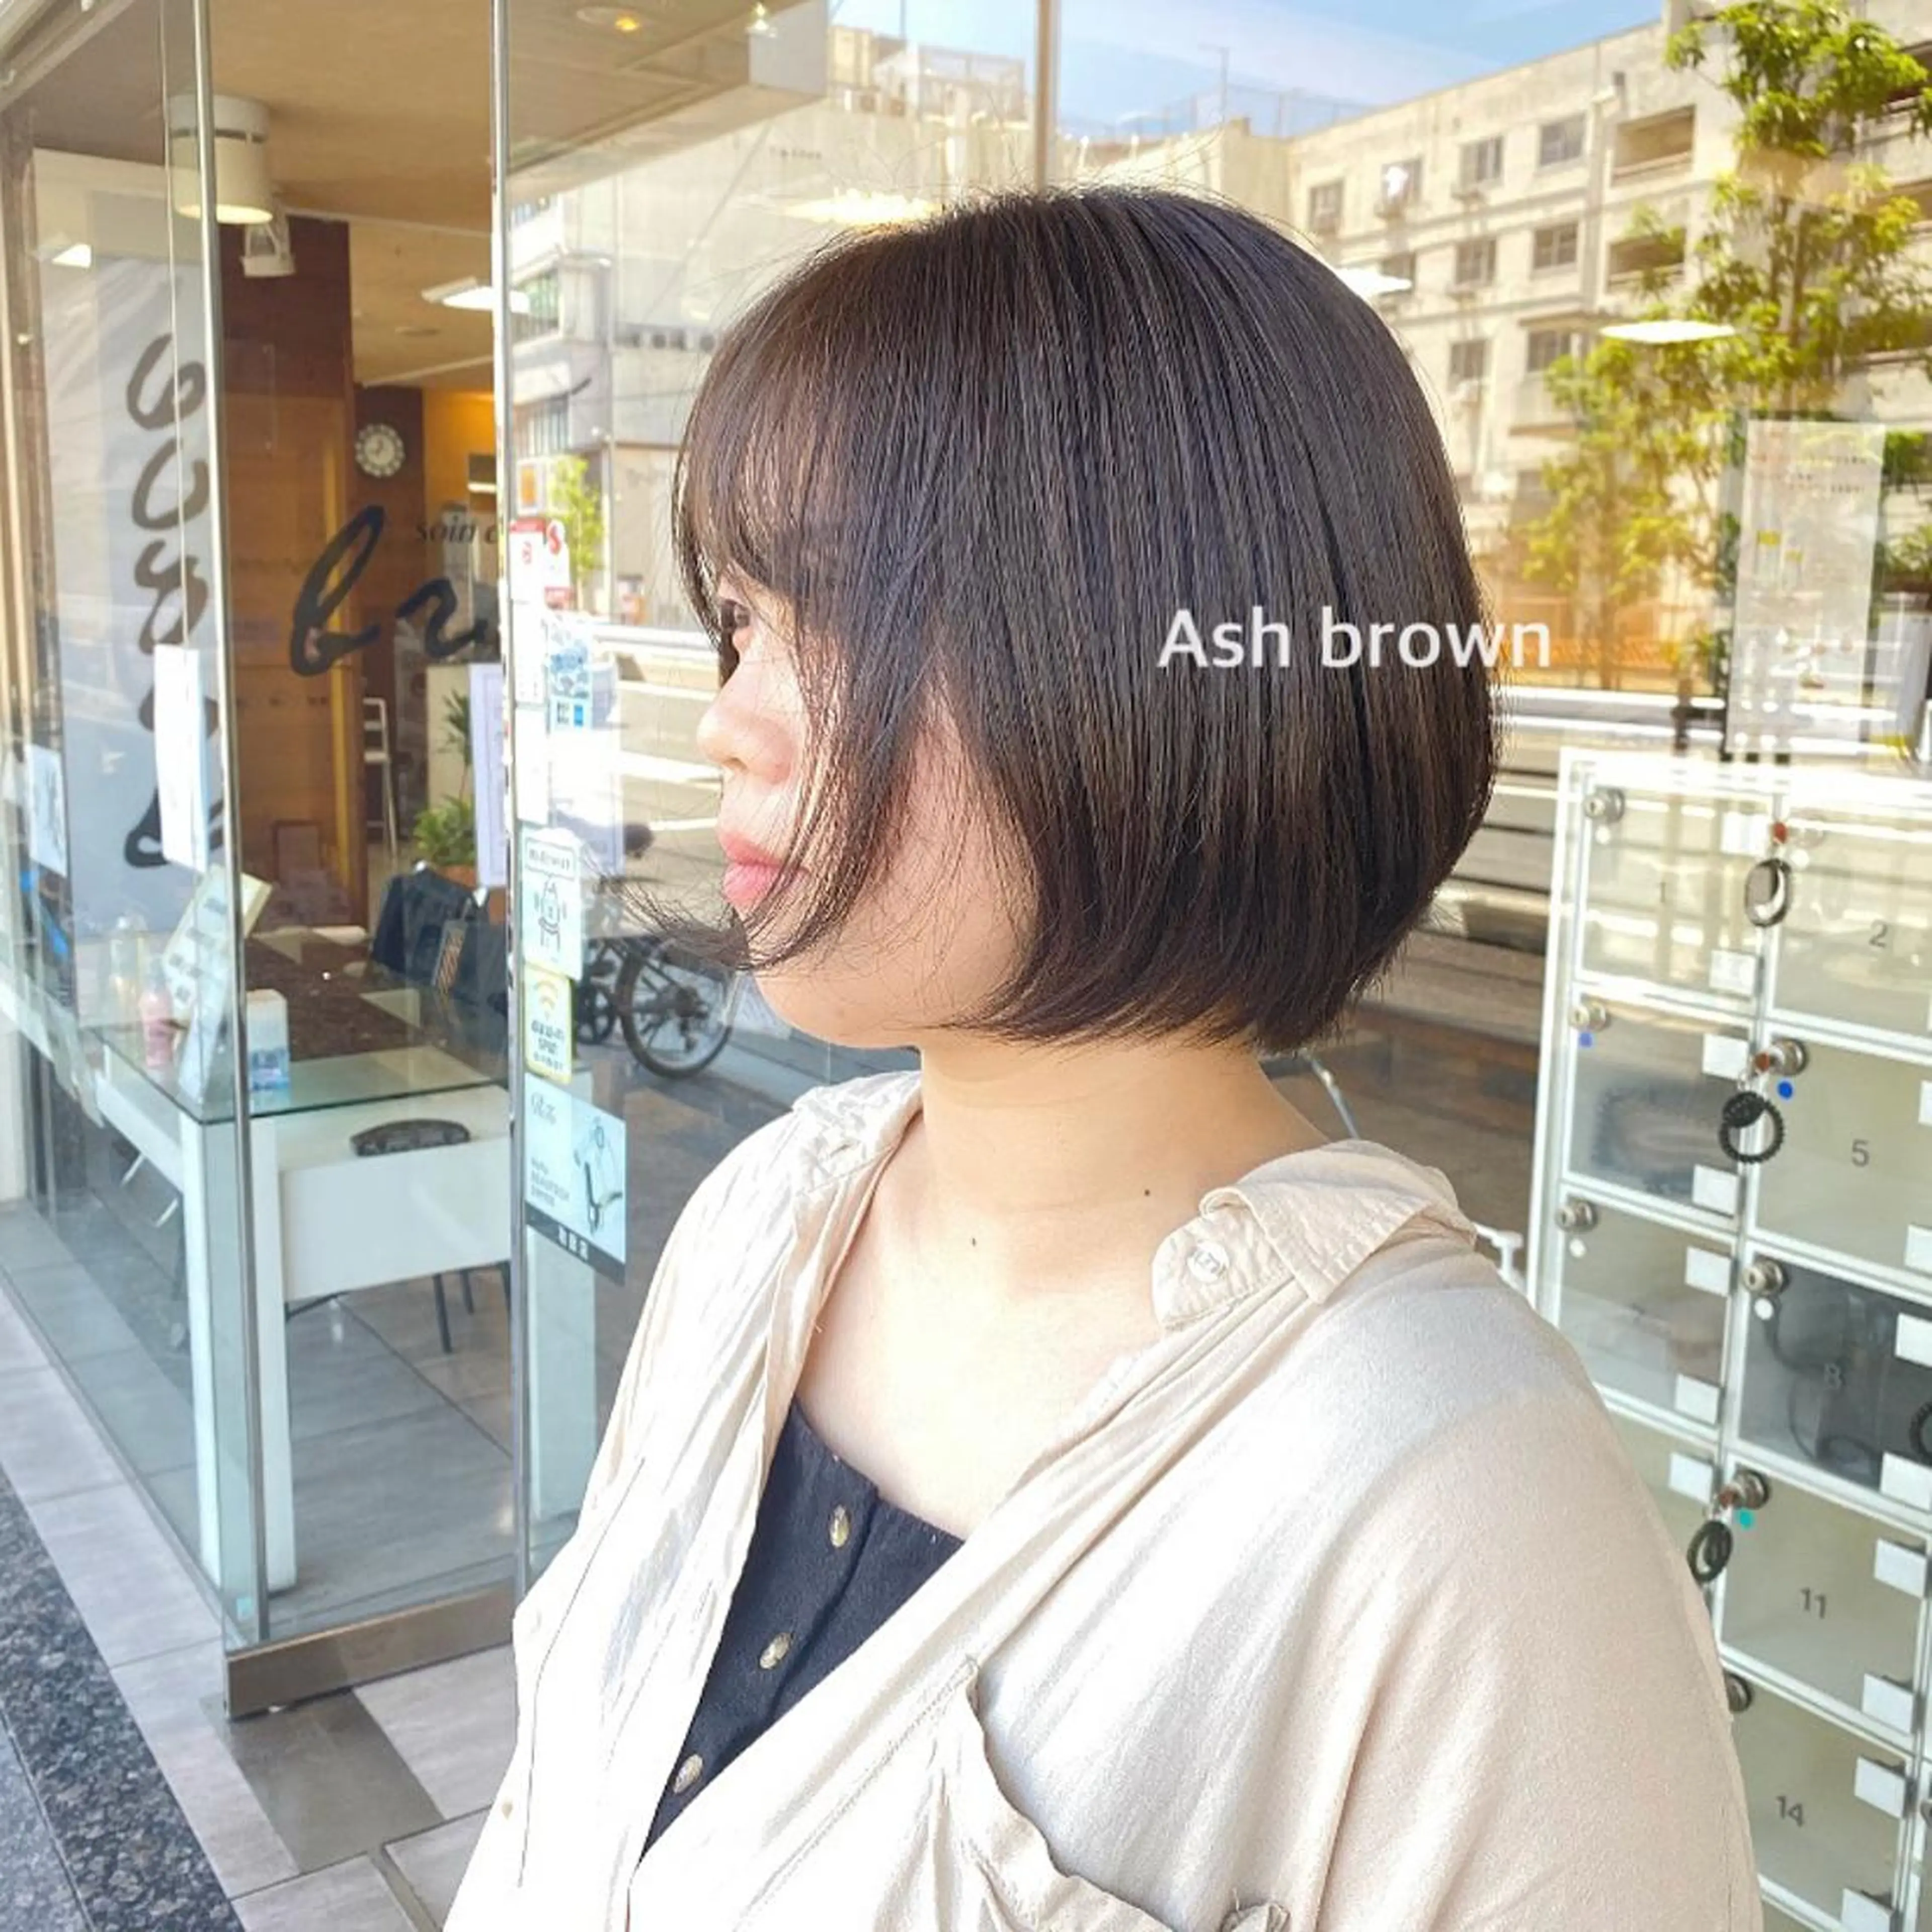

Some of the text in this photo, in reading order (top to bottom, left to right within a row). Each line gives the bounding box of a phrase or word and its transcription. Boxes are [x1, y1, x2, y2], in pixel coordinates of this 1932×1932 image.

[1869, 919, 1888, 948] 2
[1852, 1139, 1870, 1168] 5
[1800, 1587, 1826, 1620] 11
[1776, 1795, 1804, 1827] 14
